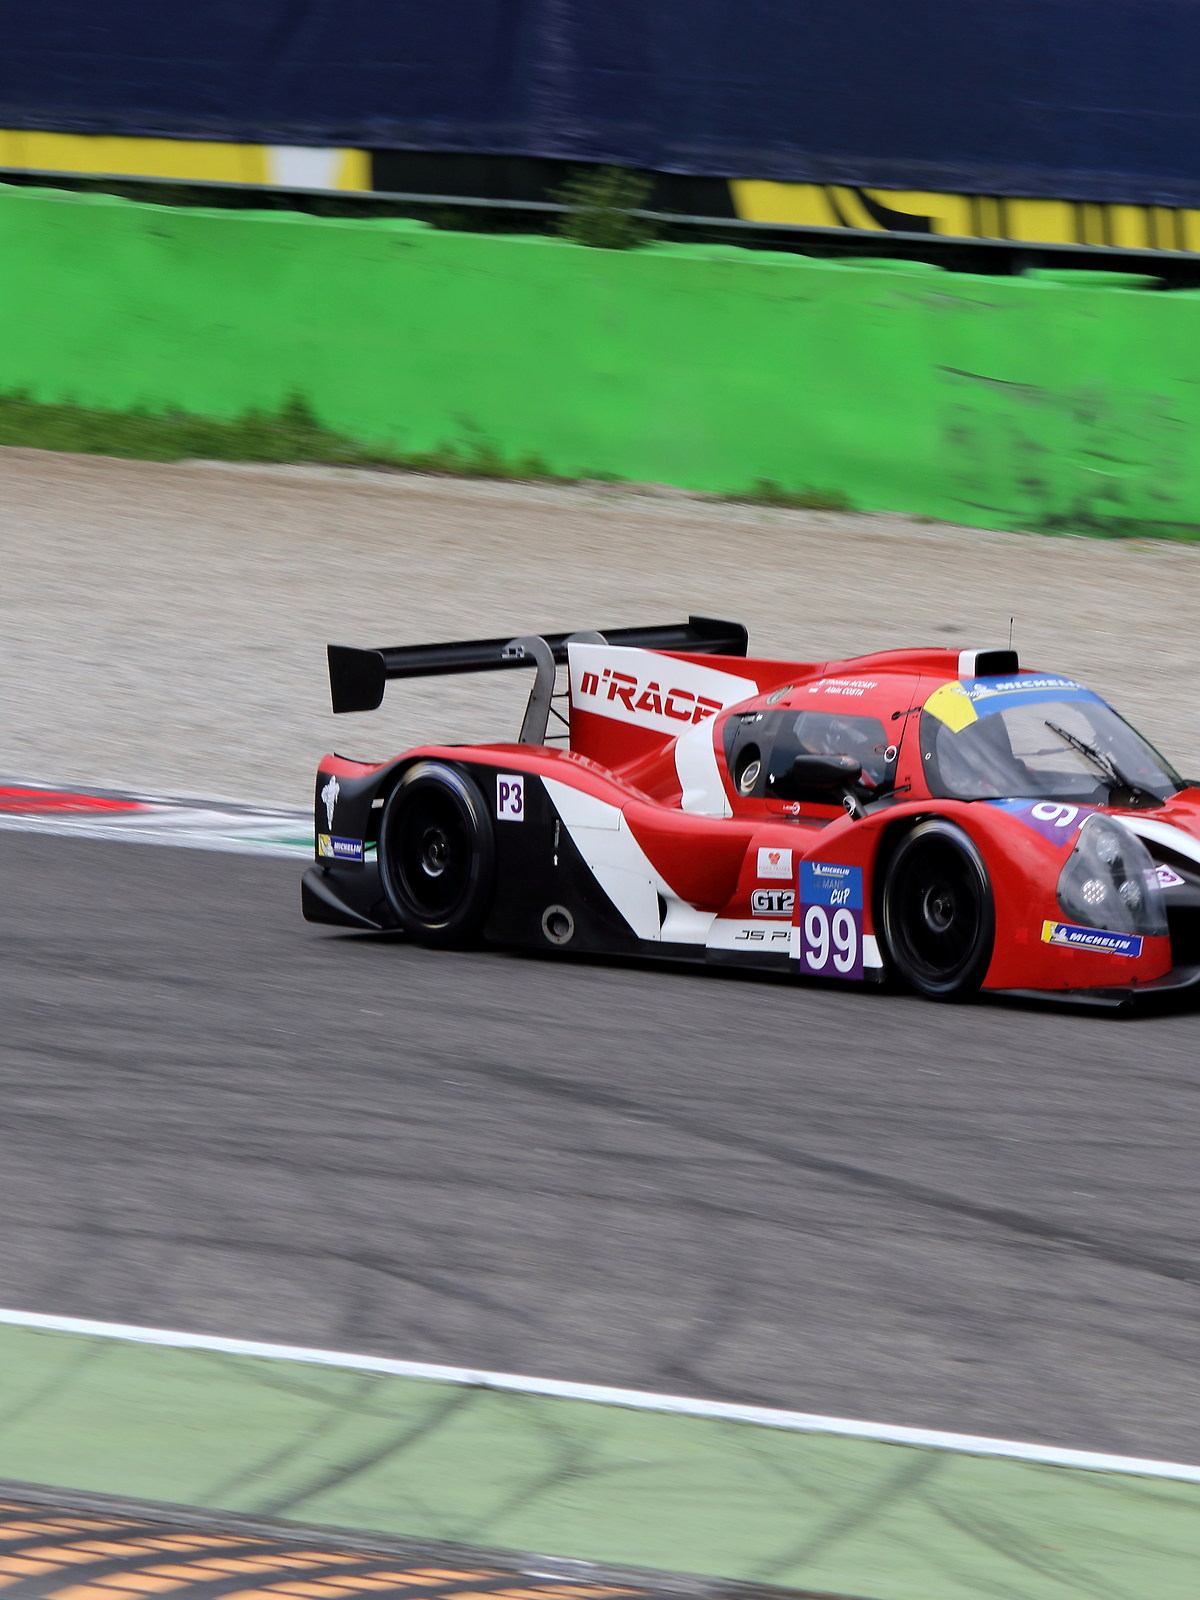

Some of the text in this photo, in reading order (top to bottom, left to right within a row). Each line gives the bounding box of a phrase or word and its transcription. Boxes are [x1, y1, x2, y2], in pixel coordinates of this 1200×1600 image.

[499, 782, 523, 814] P3
[333, 841, 362, 854] MICHELIN
[821, 866, 850, 877] MICHELIN
[830, 888, 851, 905] CUP
[734, 929, 792, 942] JS P
[804, 905, 857, 973] 99
[1069, 932, 1131, 950] MICHELIN
